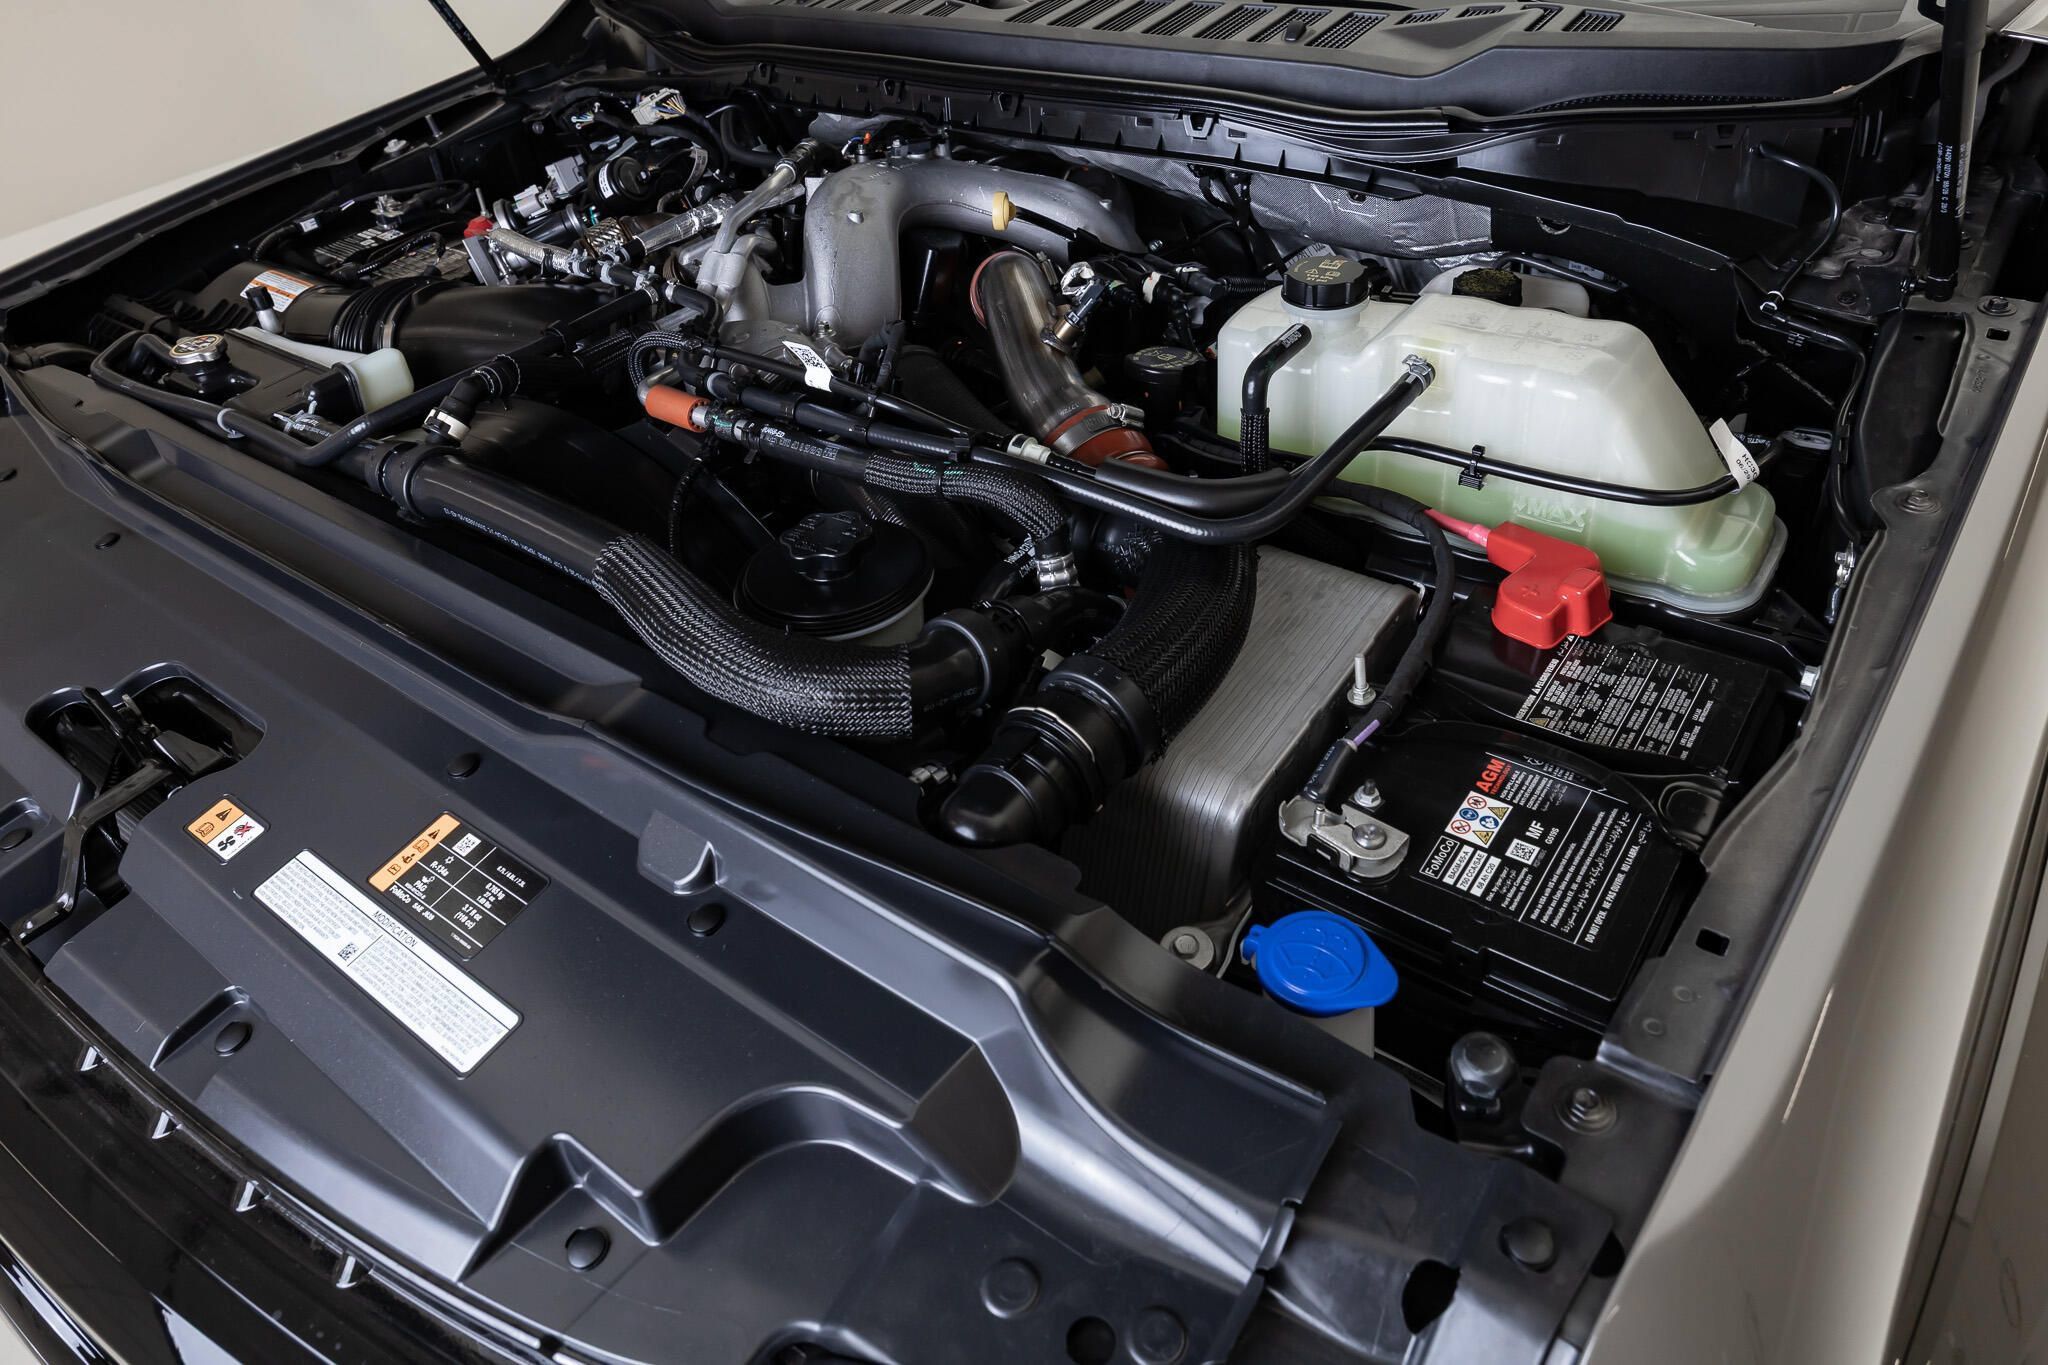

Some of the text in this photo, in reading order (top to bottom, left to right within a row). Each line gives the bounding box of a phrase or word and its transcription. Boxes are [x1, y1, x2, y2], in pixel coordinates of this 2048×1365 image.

[1528, 498, 1585, 528] MAX
[1477, 759, 1504, 791] AGM
[1491, 765, 1511, 794] TECHNOLOGY
[1526, 821, 1543, 839] MF
[1545, 828, 1559, 844] G519S
[1426, 838, 1453, 876] FoMoCo
[1448, 851, 1468, 879] BAGM-65-A
[1624, 857, 1633, 865] LA
[430, 861, 449, 876] R-134a
[1460, 854, 1484, 887] 750 CCA/SAE
[1481, 874, 1487, 882] Ah
[1485, 863, 1496, 874] C20
[1621, 863, 1630, 872] NO
[413, 880, 428, 892] PAG
[496, 890, 506, 900] kg
[389, 885, 411, 903] FoMoCo
[412, 902, 424, 913] SAE
[1501, 897, 1511, 908] Ford
[1507, 886, 1516, 898] Motor
[1602, 900, 1612, 909] NE
[1605, 891, 1616, 902] PAS
[461, 903, 473, 913] 3.7
[473, 913, 483, 922] oz
[1530, 908, 1540, 920] Made
[1539, 896, 1547, 905] USA
[372, 911, 418, 947] MODIFICATION
[1585, 934, 1595, 943] DO
[1589, 923, 1600, 935] NOT
